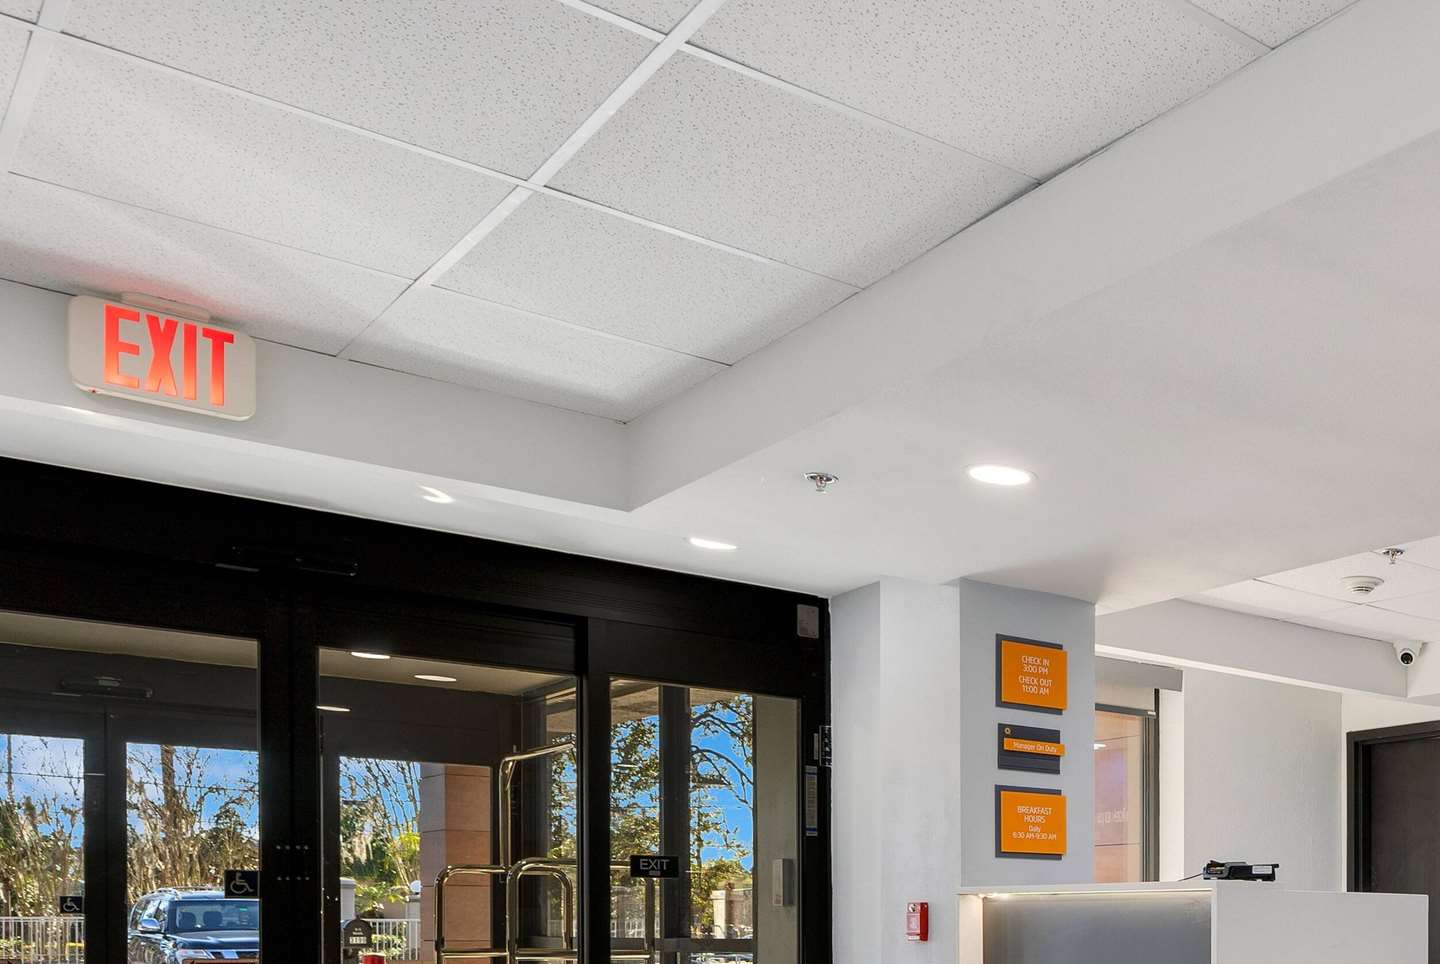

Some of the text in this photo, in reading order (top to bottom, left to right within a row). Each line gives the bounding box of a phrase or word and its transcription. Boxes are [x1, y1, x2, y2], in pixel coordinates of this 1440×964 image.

[103, 303, 235, 407] EXIT
[1021, 655, 1050, 667] CHECK IN
[1038, 666, 1049, 675] PM
[1018, 675, 1053, 688] CHECK OUT
[1039, 687, 1050, 697] AM
[1016, 805, 1053, 816] BREAKFAST
[1023, 815, 1047, 824] HOURS
[640, 858, 670, 870] EXIT
